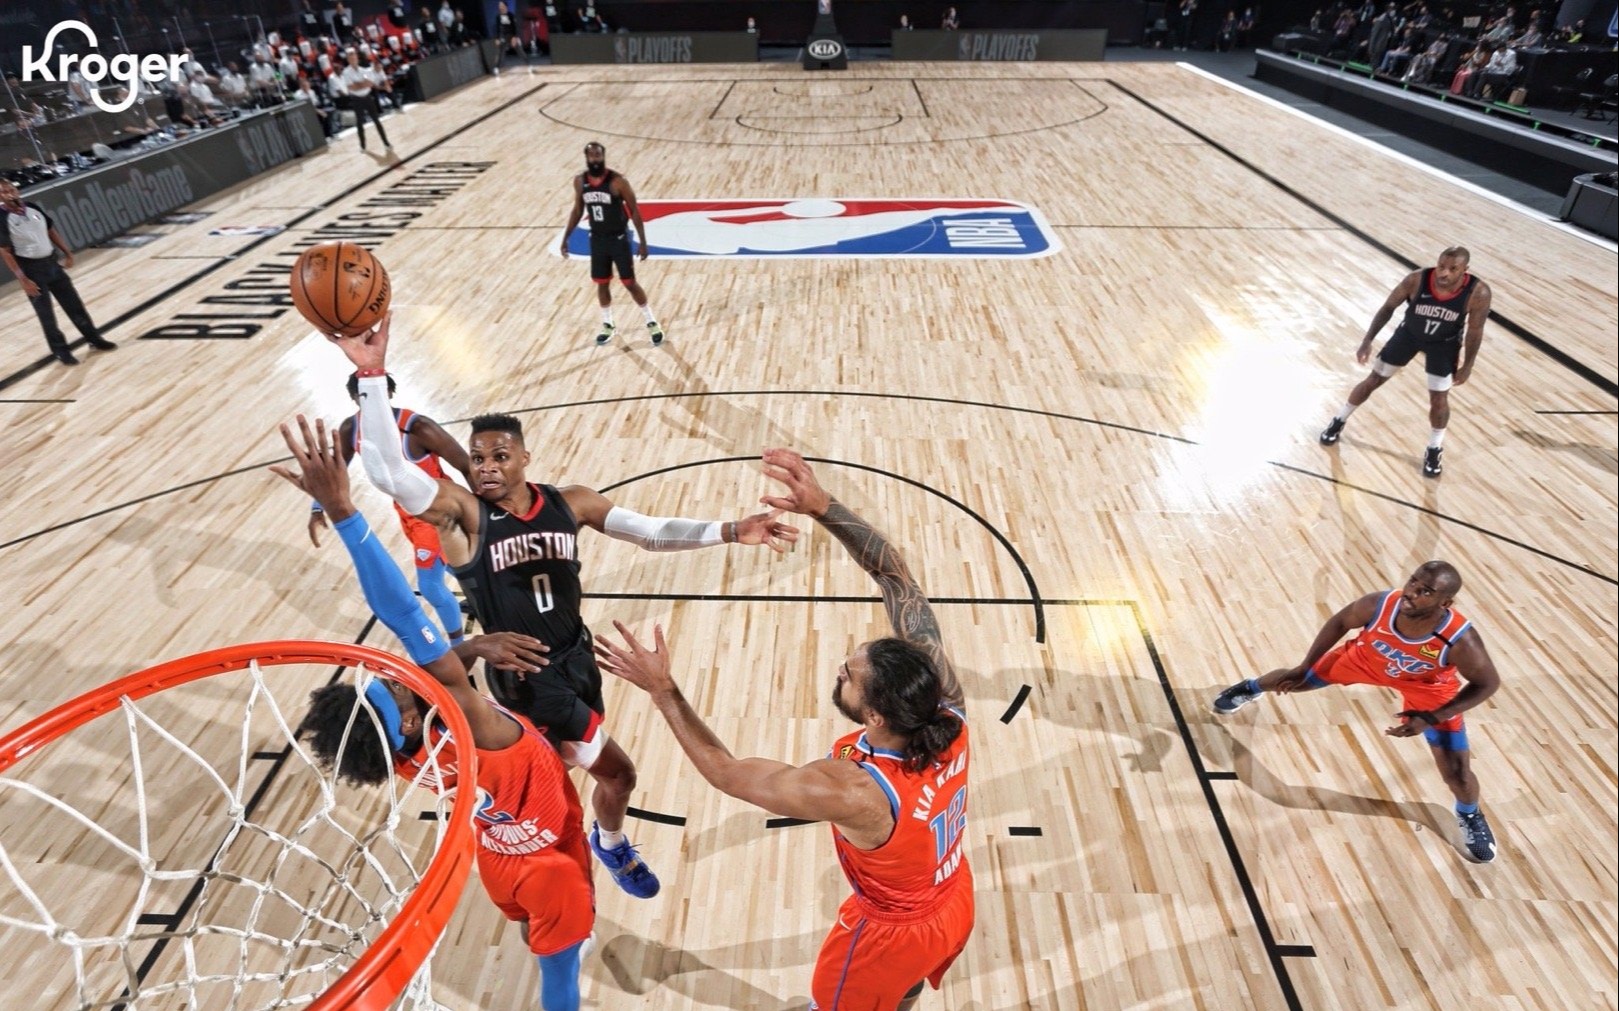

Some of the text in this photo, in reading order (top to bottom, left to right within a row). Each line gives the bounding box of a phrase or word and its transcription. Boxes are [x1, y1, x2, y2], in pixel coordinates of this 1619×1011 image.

[627, 36, 692, 62] PLAYOFFS
[814, 44, 836, 54] KIA
[971, 34, 1039, 60] PLAYOFFS
[357, 160, 499, 208] MATTER
[591, 205, 604, 221] 13
[942, 218, 1027, 248] NBA
[1415, 304, 1460, 321] HOUSTON
[1423, 319, 1441, 335] 17
[489, 532, 575, 573] HOUSTON
[532, 573, 554, 614] 0
[1371, 639, 1436, 674] OKC
[912, 784, 936, 821] KIA
[929, 784, 967, 866] 12
